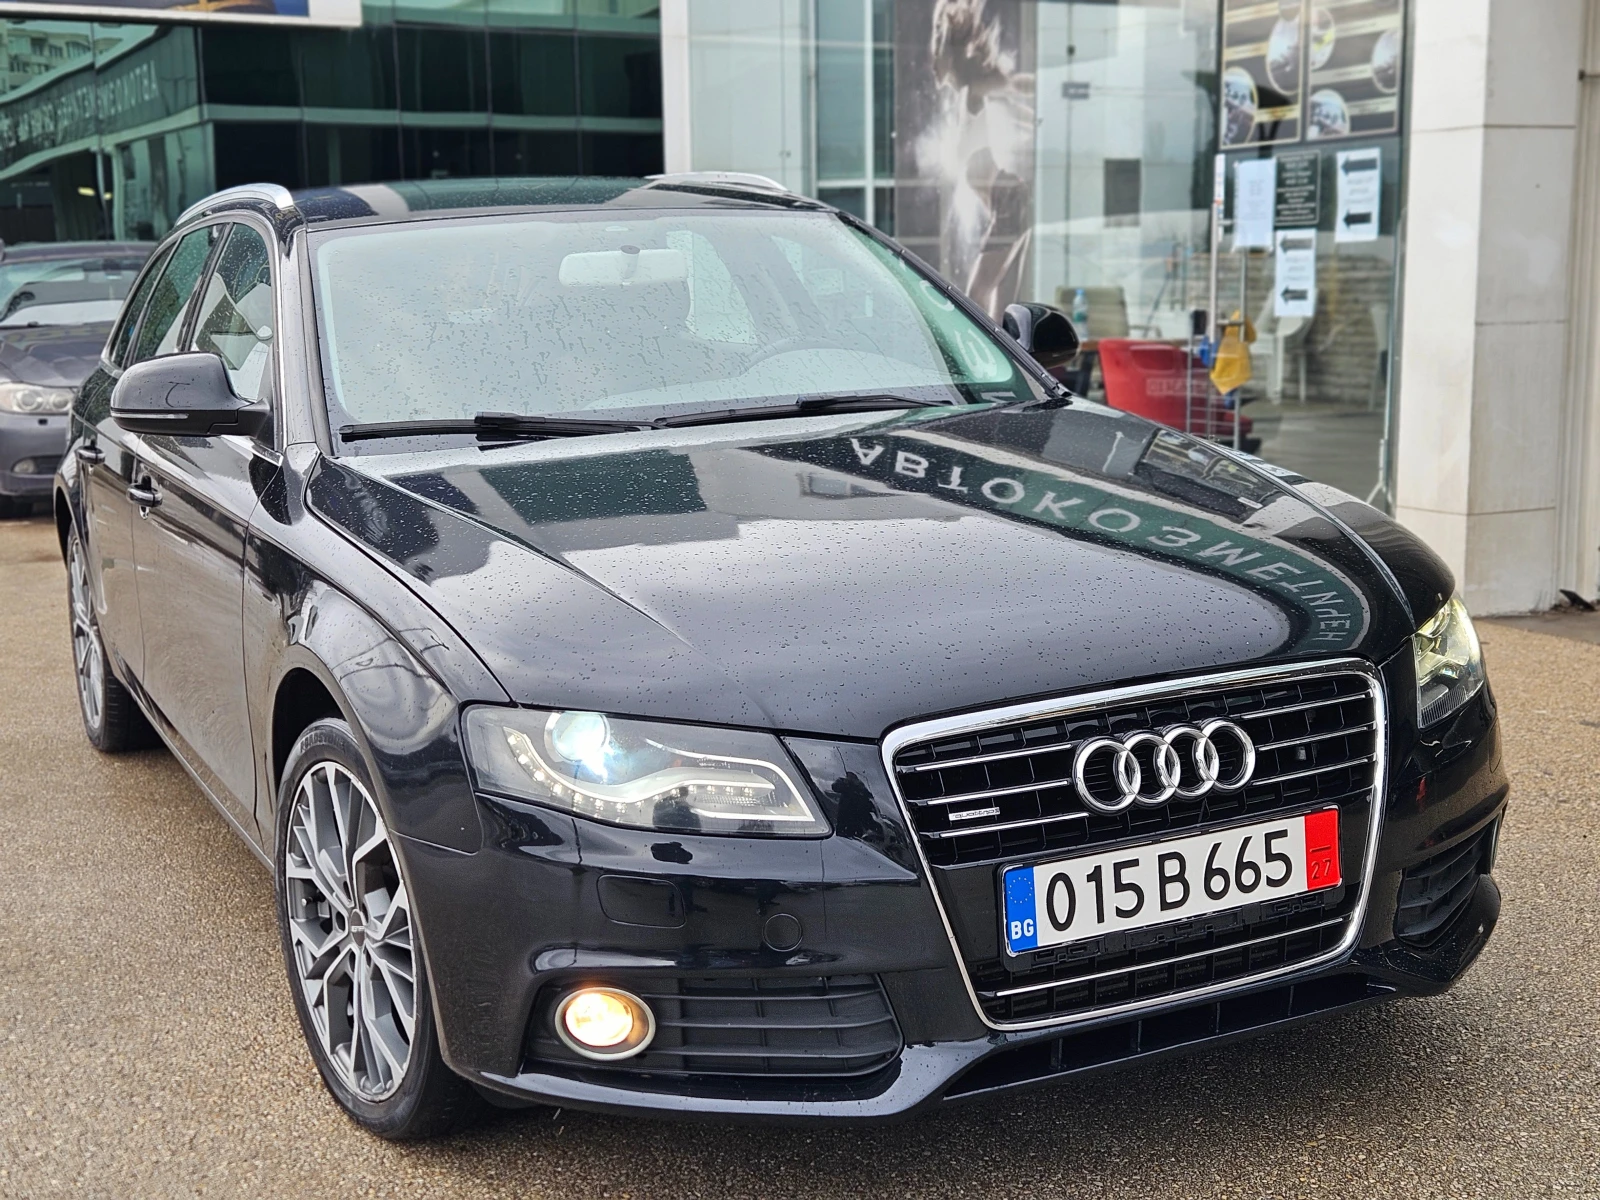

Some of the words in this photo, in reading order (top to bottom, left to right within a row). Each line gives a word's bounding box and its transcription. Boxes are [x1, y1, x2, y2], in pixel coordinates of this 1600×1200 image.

[1046, 858, 1145, 932] 015
[1203, 828, 1293, 901] 665
[1311, 857, 1331, 880] 27
[1011, 918, 1034, 940] BG
